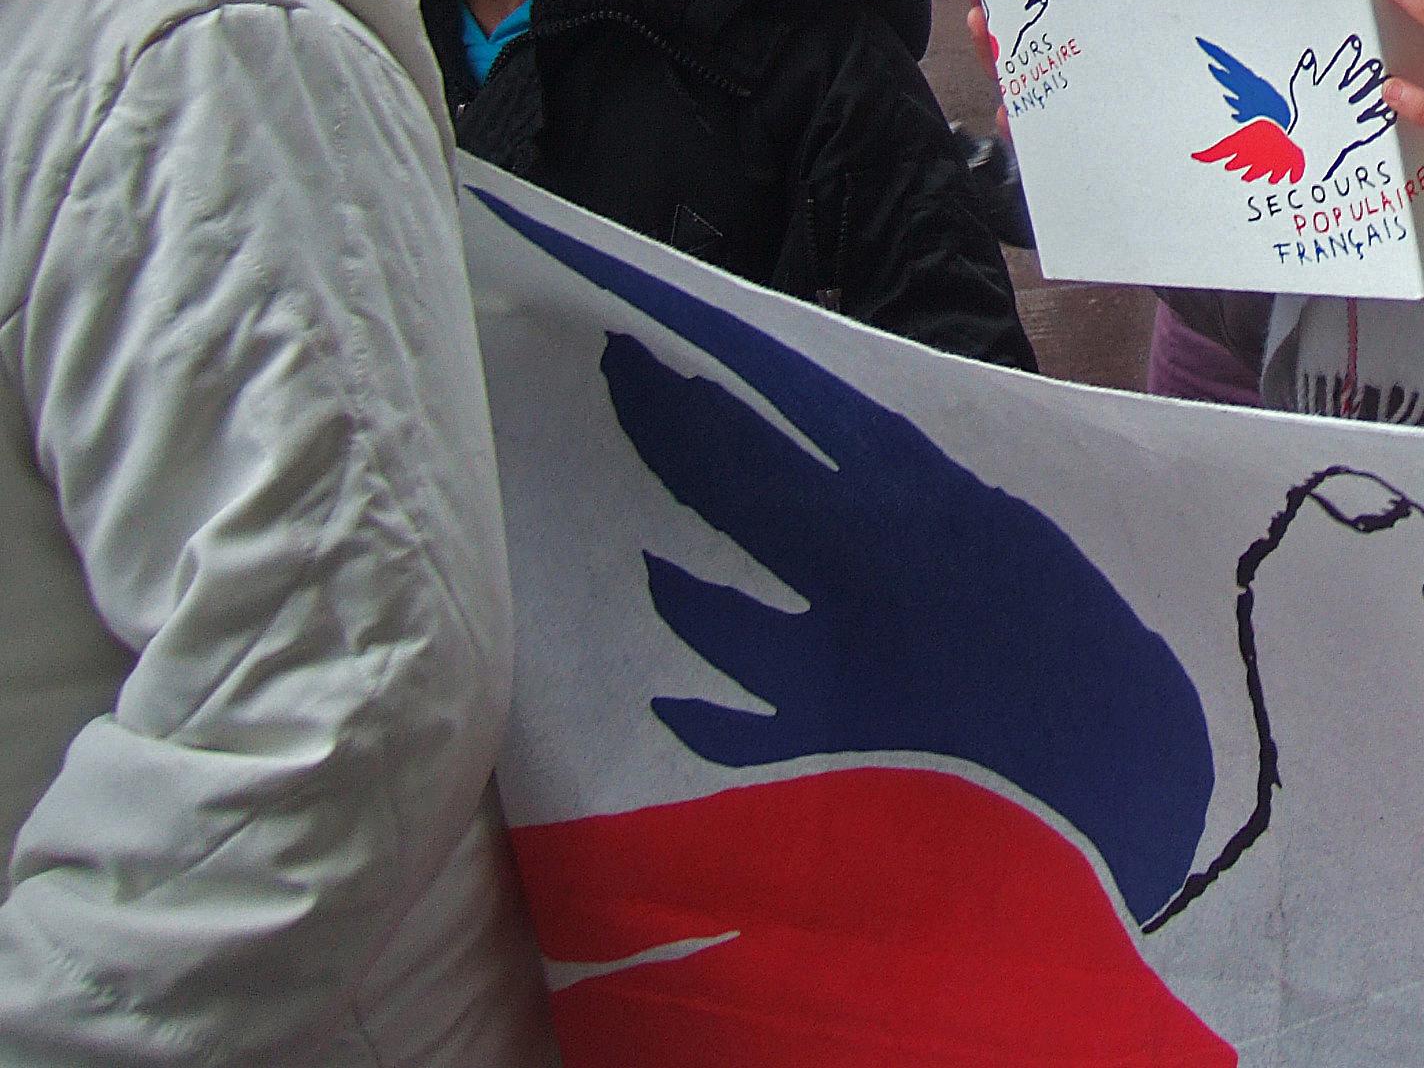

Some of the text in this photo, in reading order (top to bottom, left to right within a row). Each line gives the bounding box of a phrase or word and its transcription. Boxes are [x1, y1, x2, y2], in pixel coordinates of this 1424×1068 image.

[1000, 33, 1052, 80] OURS
[1008, 71, 1068, 117] ANÇAIS
[1247, 160, 1391, 222] SECOURS
[1273, 216, 1406, 266] FRANÇAIS
